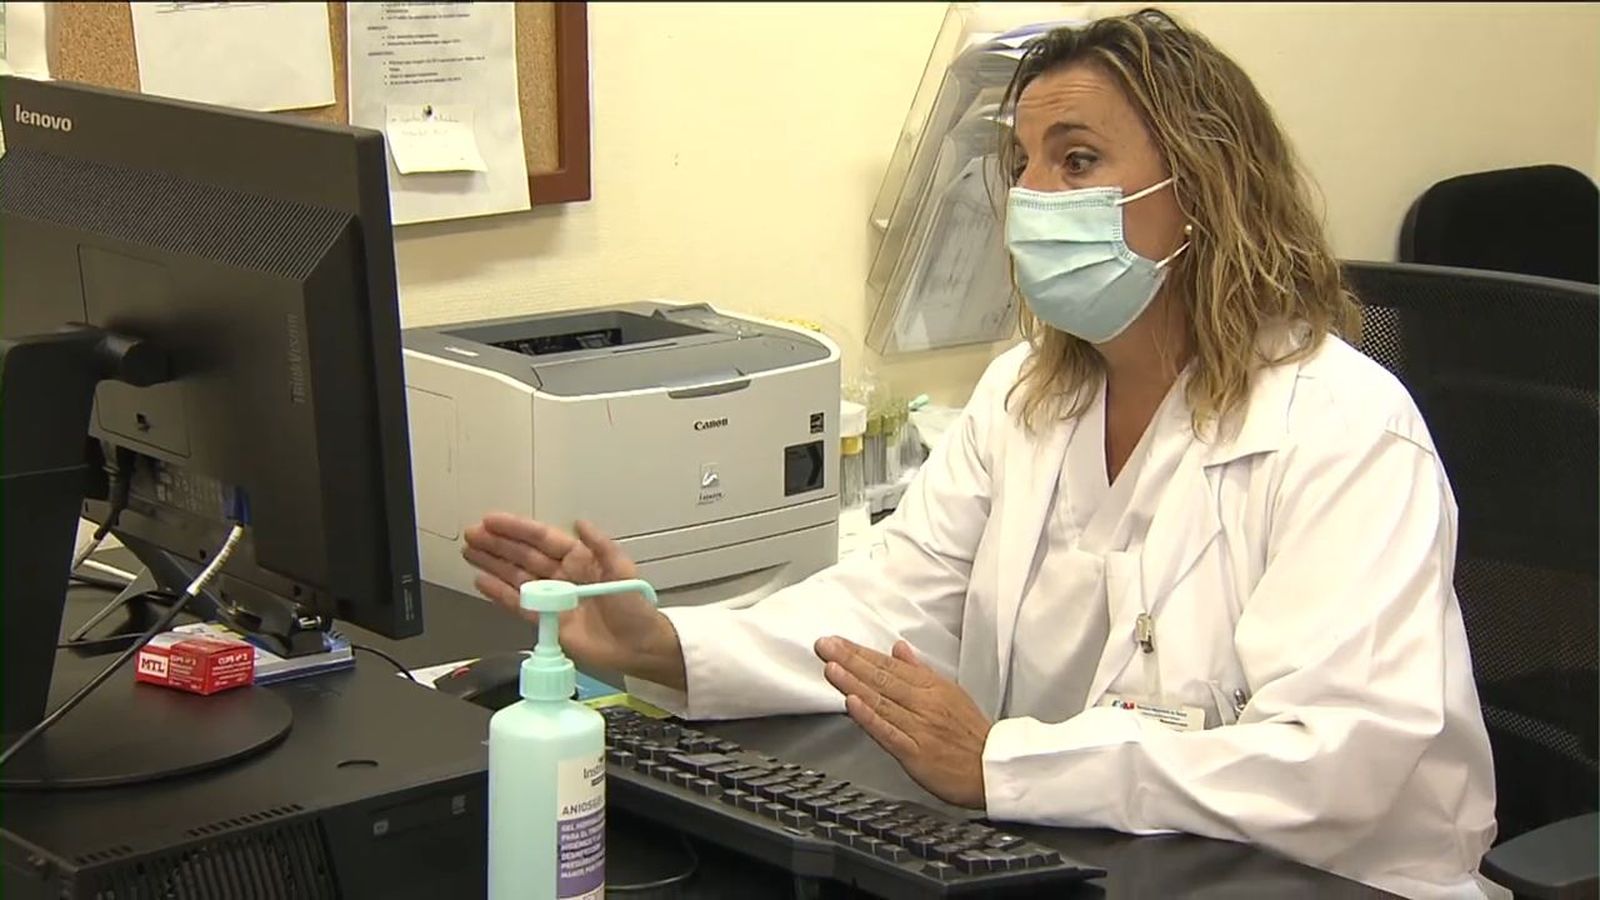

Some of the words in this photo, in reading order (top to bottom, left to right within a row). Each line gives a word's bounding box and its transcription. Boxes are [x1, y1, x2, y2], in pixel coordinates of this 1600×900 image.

[16, 104, 72, 132] lenovo
[694, 417, 729, 430] Canon
[141, 658, 165, 674] MTL
